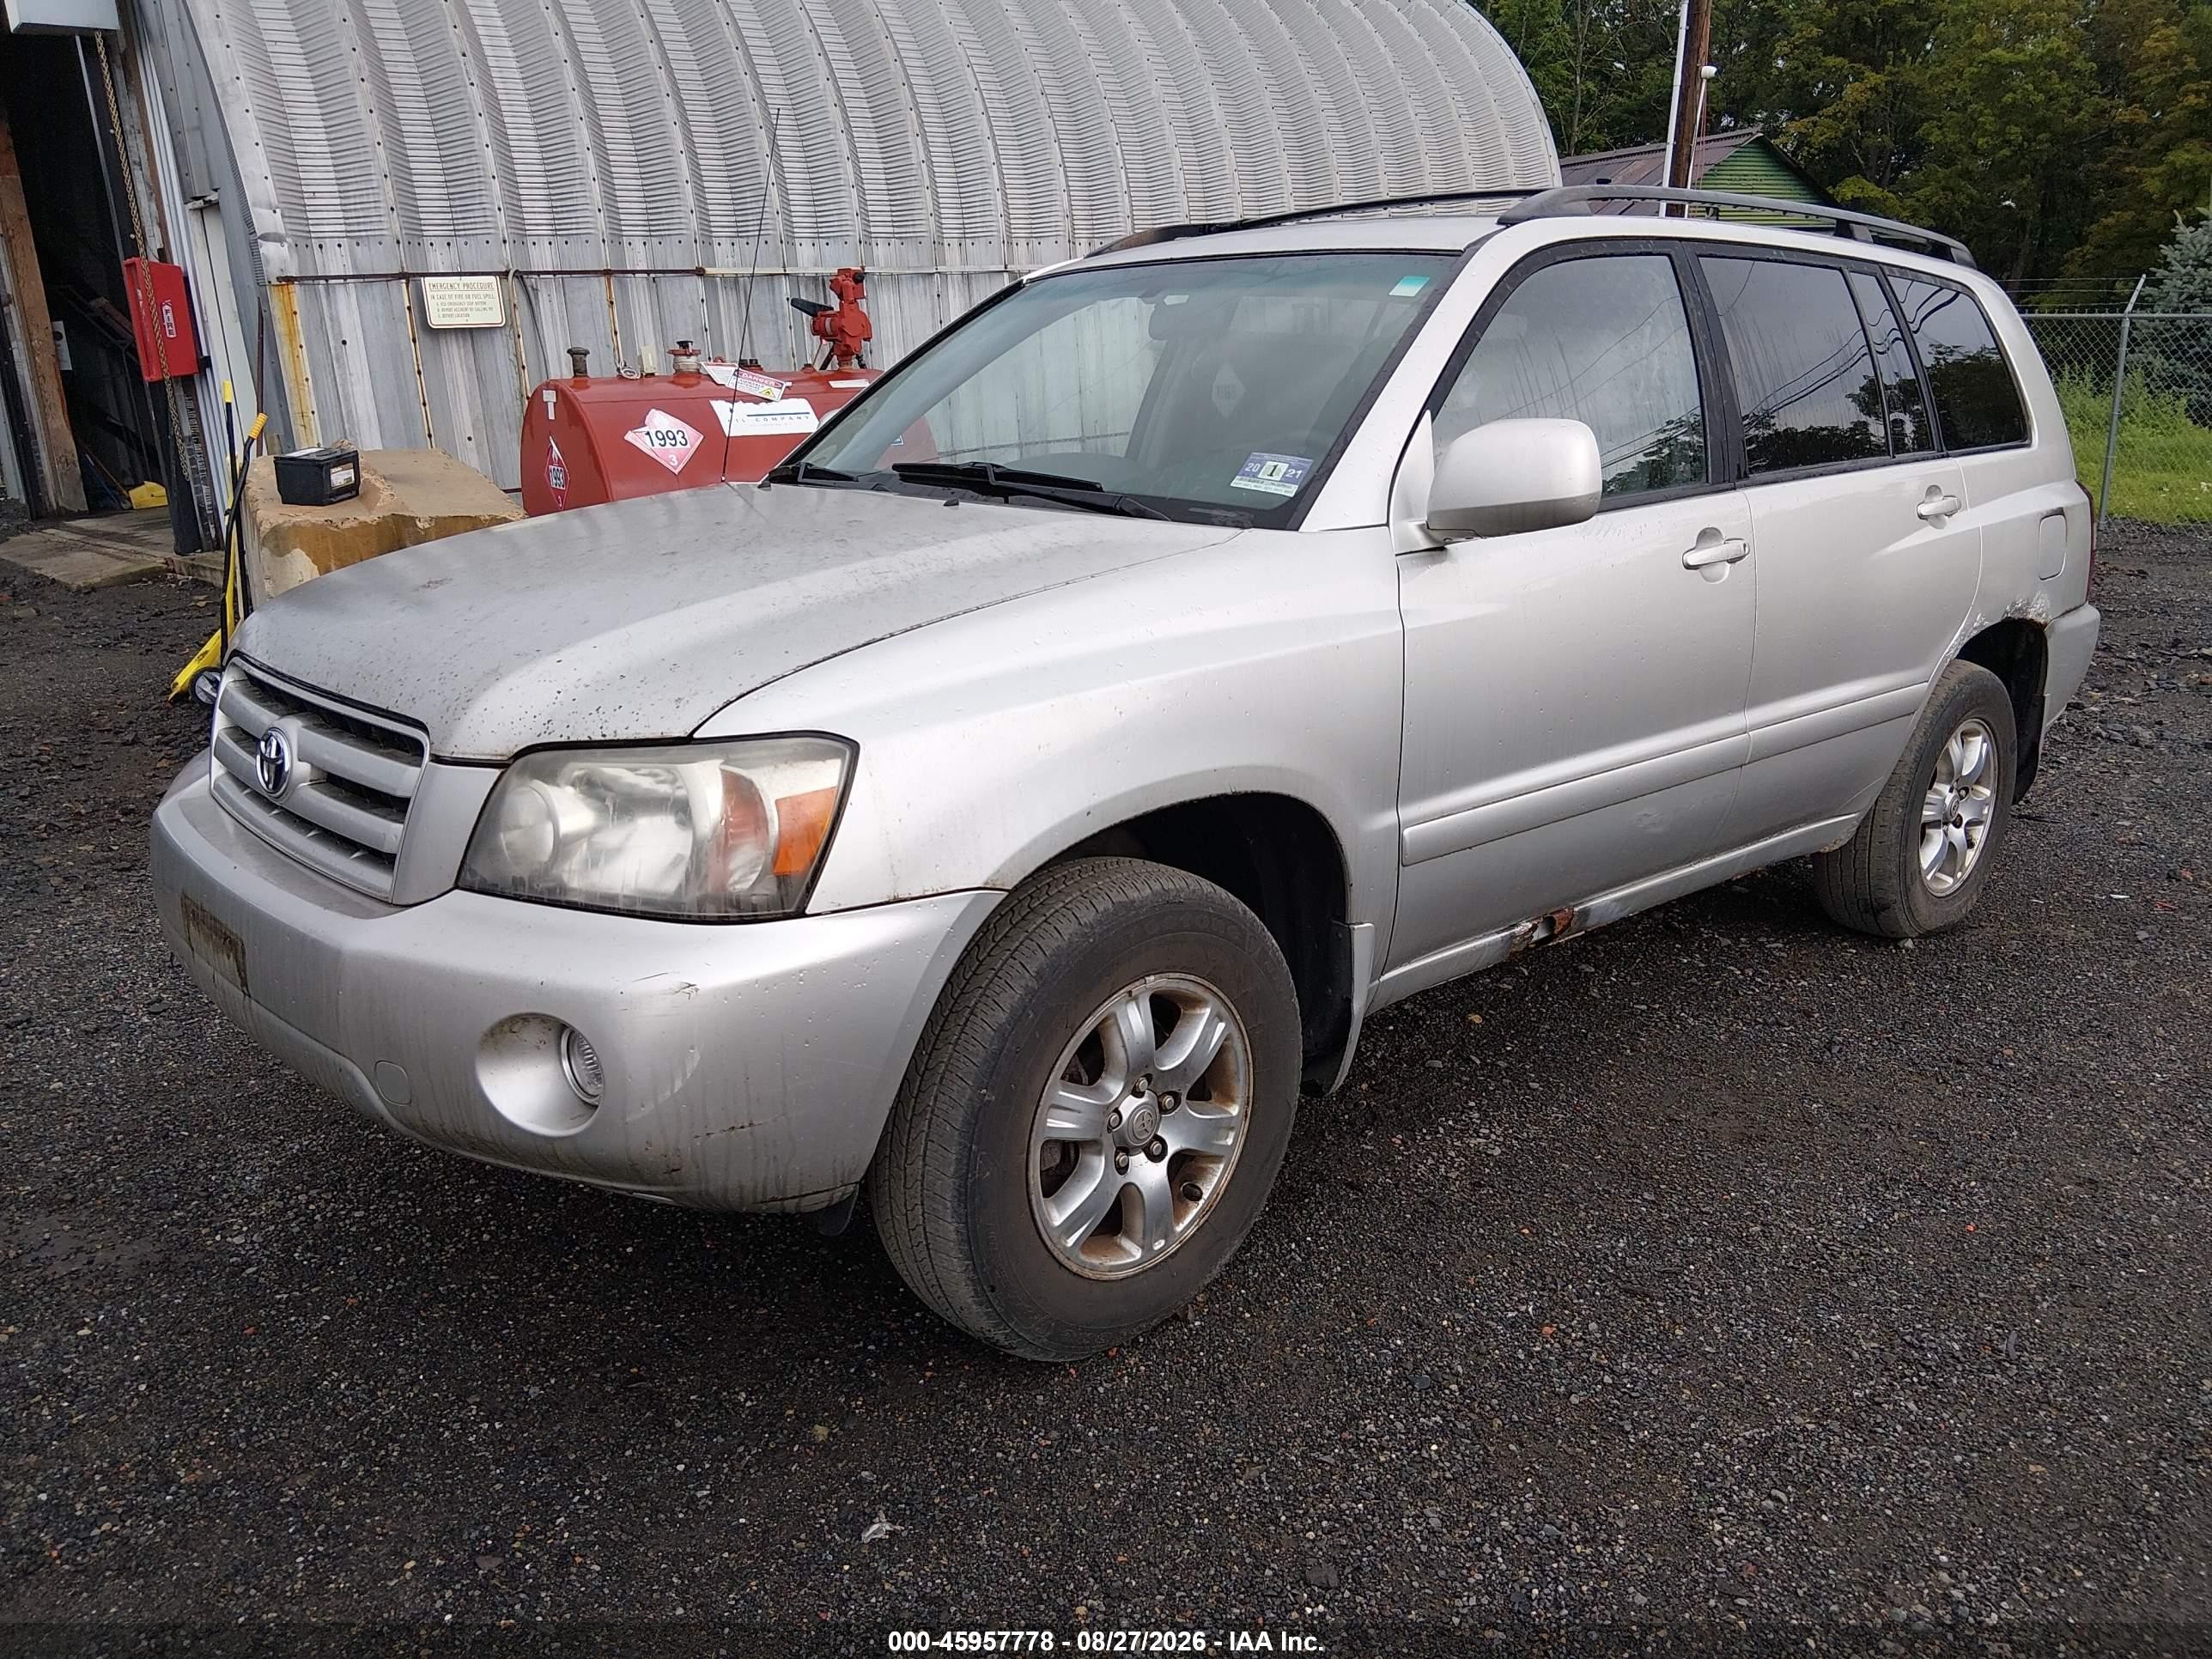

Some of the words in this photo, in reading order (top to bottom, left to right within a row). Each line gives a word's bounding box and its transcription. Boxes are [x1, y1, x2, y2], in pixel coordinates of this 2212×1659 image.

[463, 282, 494, 290] PROCEDURE
[164, 309, 175, 336] FIRE
[742, 373, 776, 388] DANGER
[645, 429, 688, 447] 1993
[668, 453, 678, 466] 3
[549, 468, 565, 489] 1993
[1243, 463, 1261, 473] 20
[1266, 464, 1279, 477] 1
[1284, 469, 1303, 479] 21
[558, 497, 562, 507] 3
